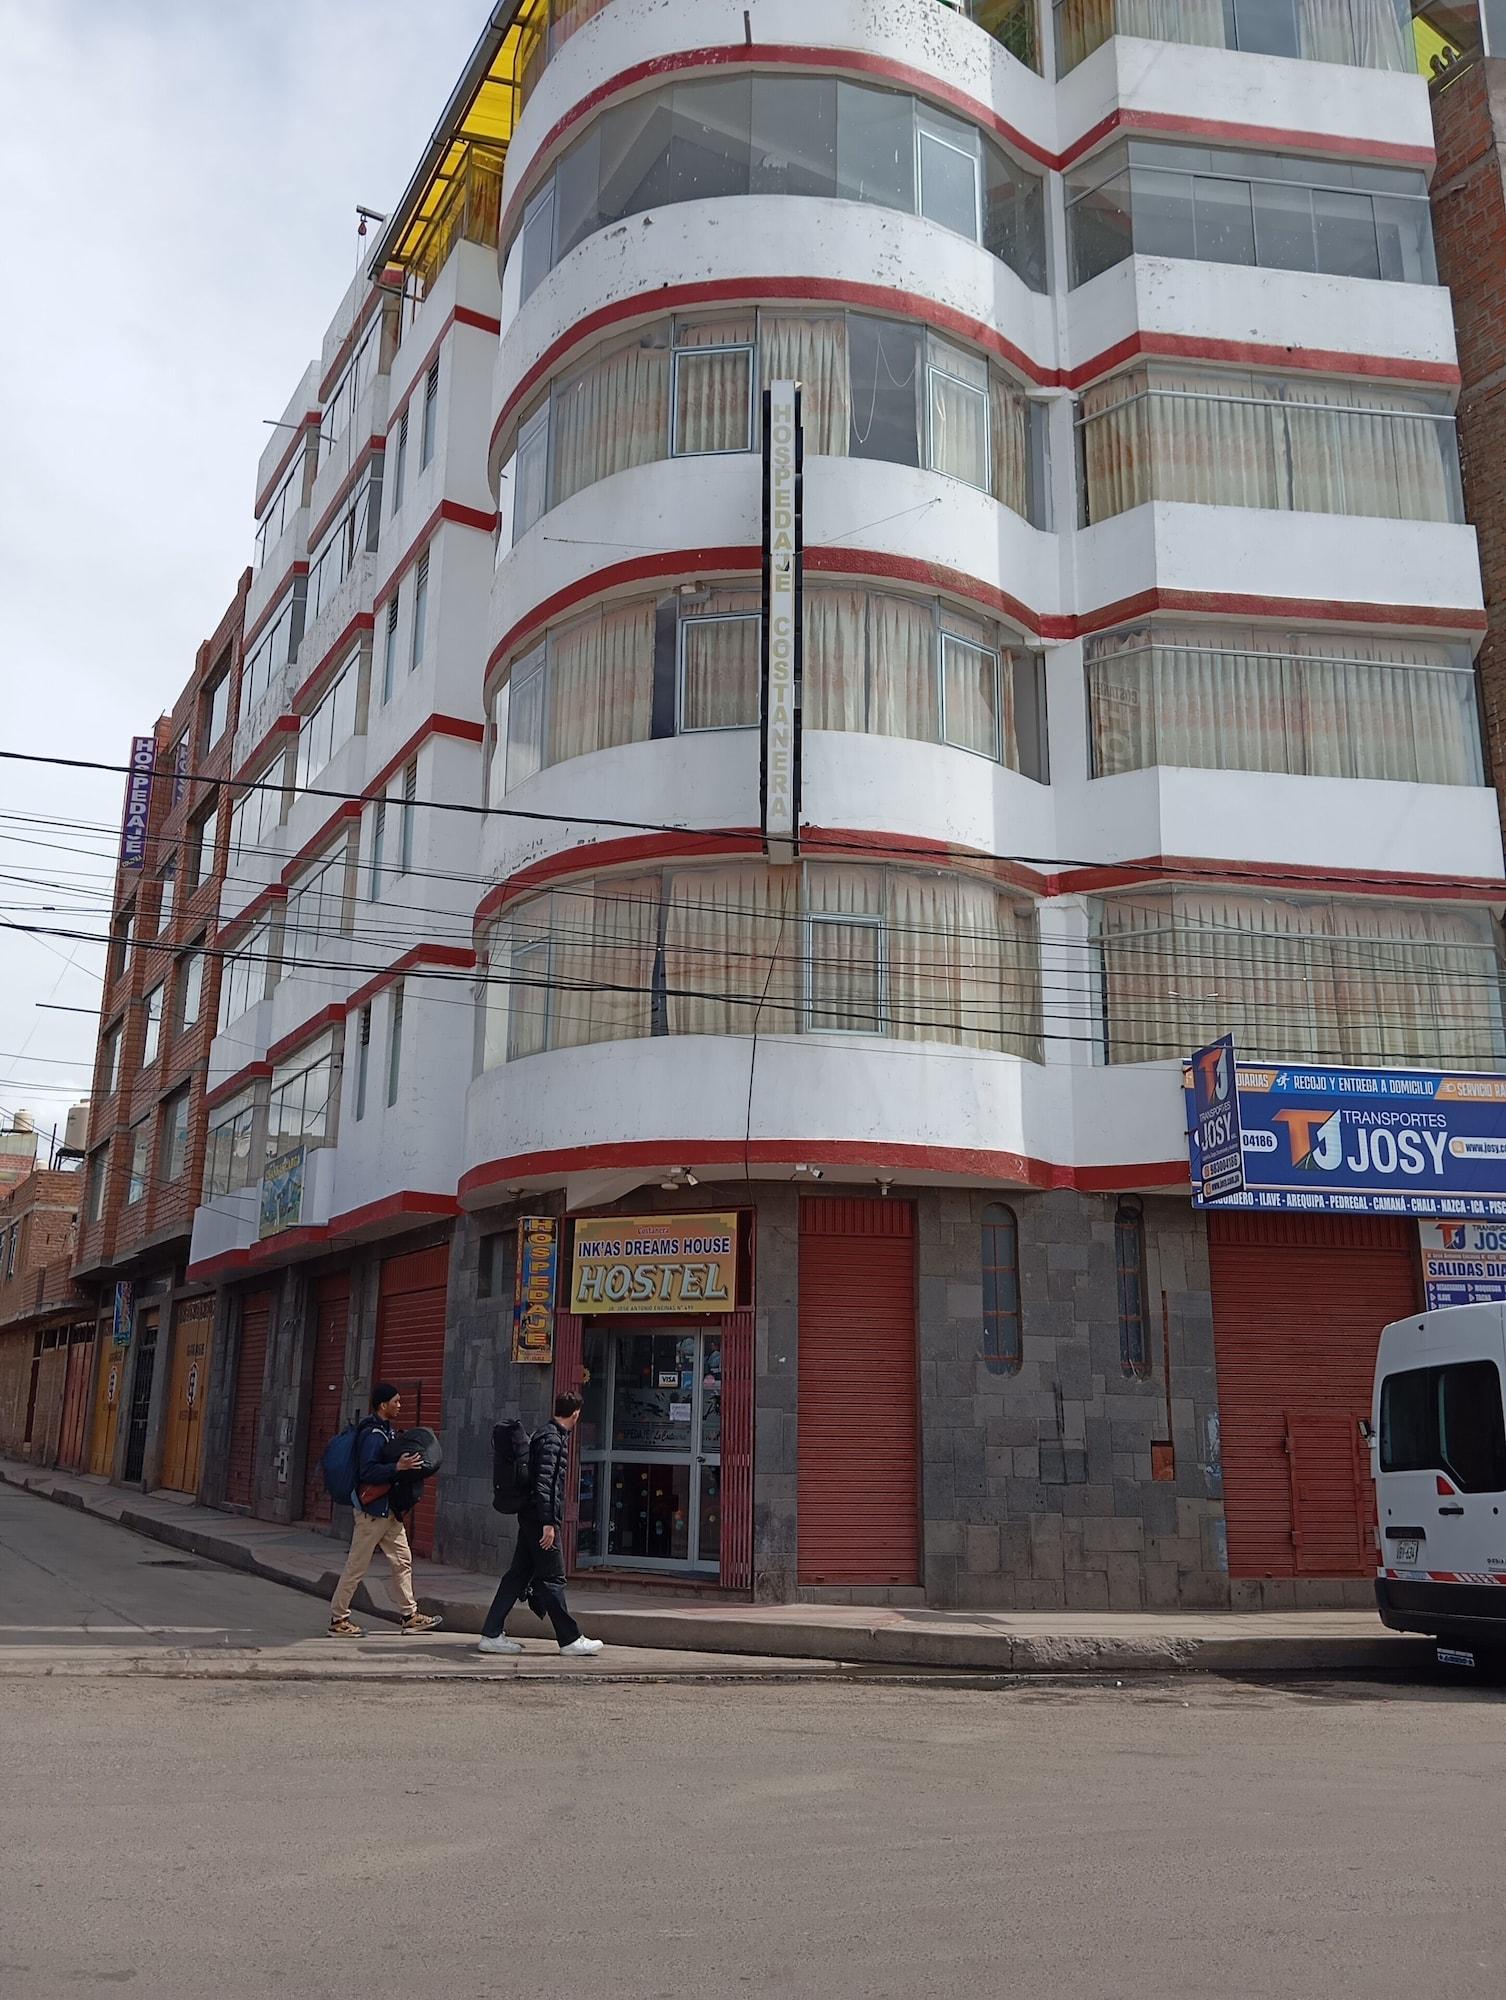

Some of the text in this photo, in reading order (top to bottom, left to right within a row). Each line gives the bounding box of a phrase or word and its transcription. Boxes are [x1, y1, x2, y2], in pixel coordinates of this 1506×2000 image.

[770, 405, 793, 816] HOSPEDAJE COSTANERA
[125, 739, 154, 853] HOSPEDAJE
[1294, 1075, 1326, 1090] RECOJO
[1329, 1077, 1336, 1091] Y
[1339, 1077, 1378, 1093] ENTREGA
[1381, 1080, 1387, 1093] A
[1390, 1080, 1434, 1095] DOMICILIO
[1457, 1082, 1492, 1097] SERVICIO
[1199, 1101, 1231, 1121] TRANSPORTES
[1342, 1110, 1447, 1127] TRANSPORTES
[1202, 1112, 1232, 1151] JOSY
[1347, 1128, 1448, 1175] JOSY
[1260, 1193, 1281, 1206] ILAVE
[1287, 1194, 1325, 1208] AREQUIPA
[1330, 1196, 1368, 1209] PEDREGAL
[1374, 1195, 1407, 1211] CAMANÁ
[1412, 1198, 1436, 1212] CHALA
[1442, 1199, 1466, 1213] NAZCA
[1471, 1200, 1484, 1214] ICA
[578, 1237, 730, 1257] INK'AS DREAMS HOUSE
[526, 1219, 553, 1346] HOSPEDAJE
[577, 1263, 728, 1302] HOSTEL
[1428, 1262, 1483, 1276] SALIDAS
